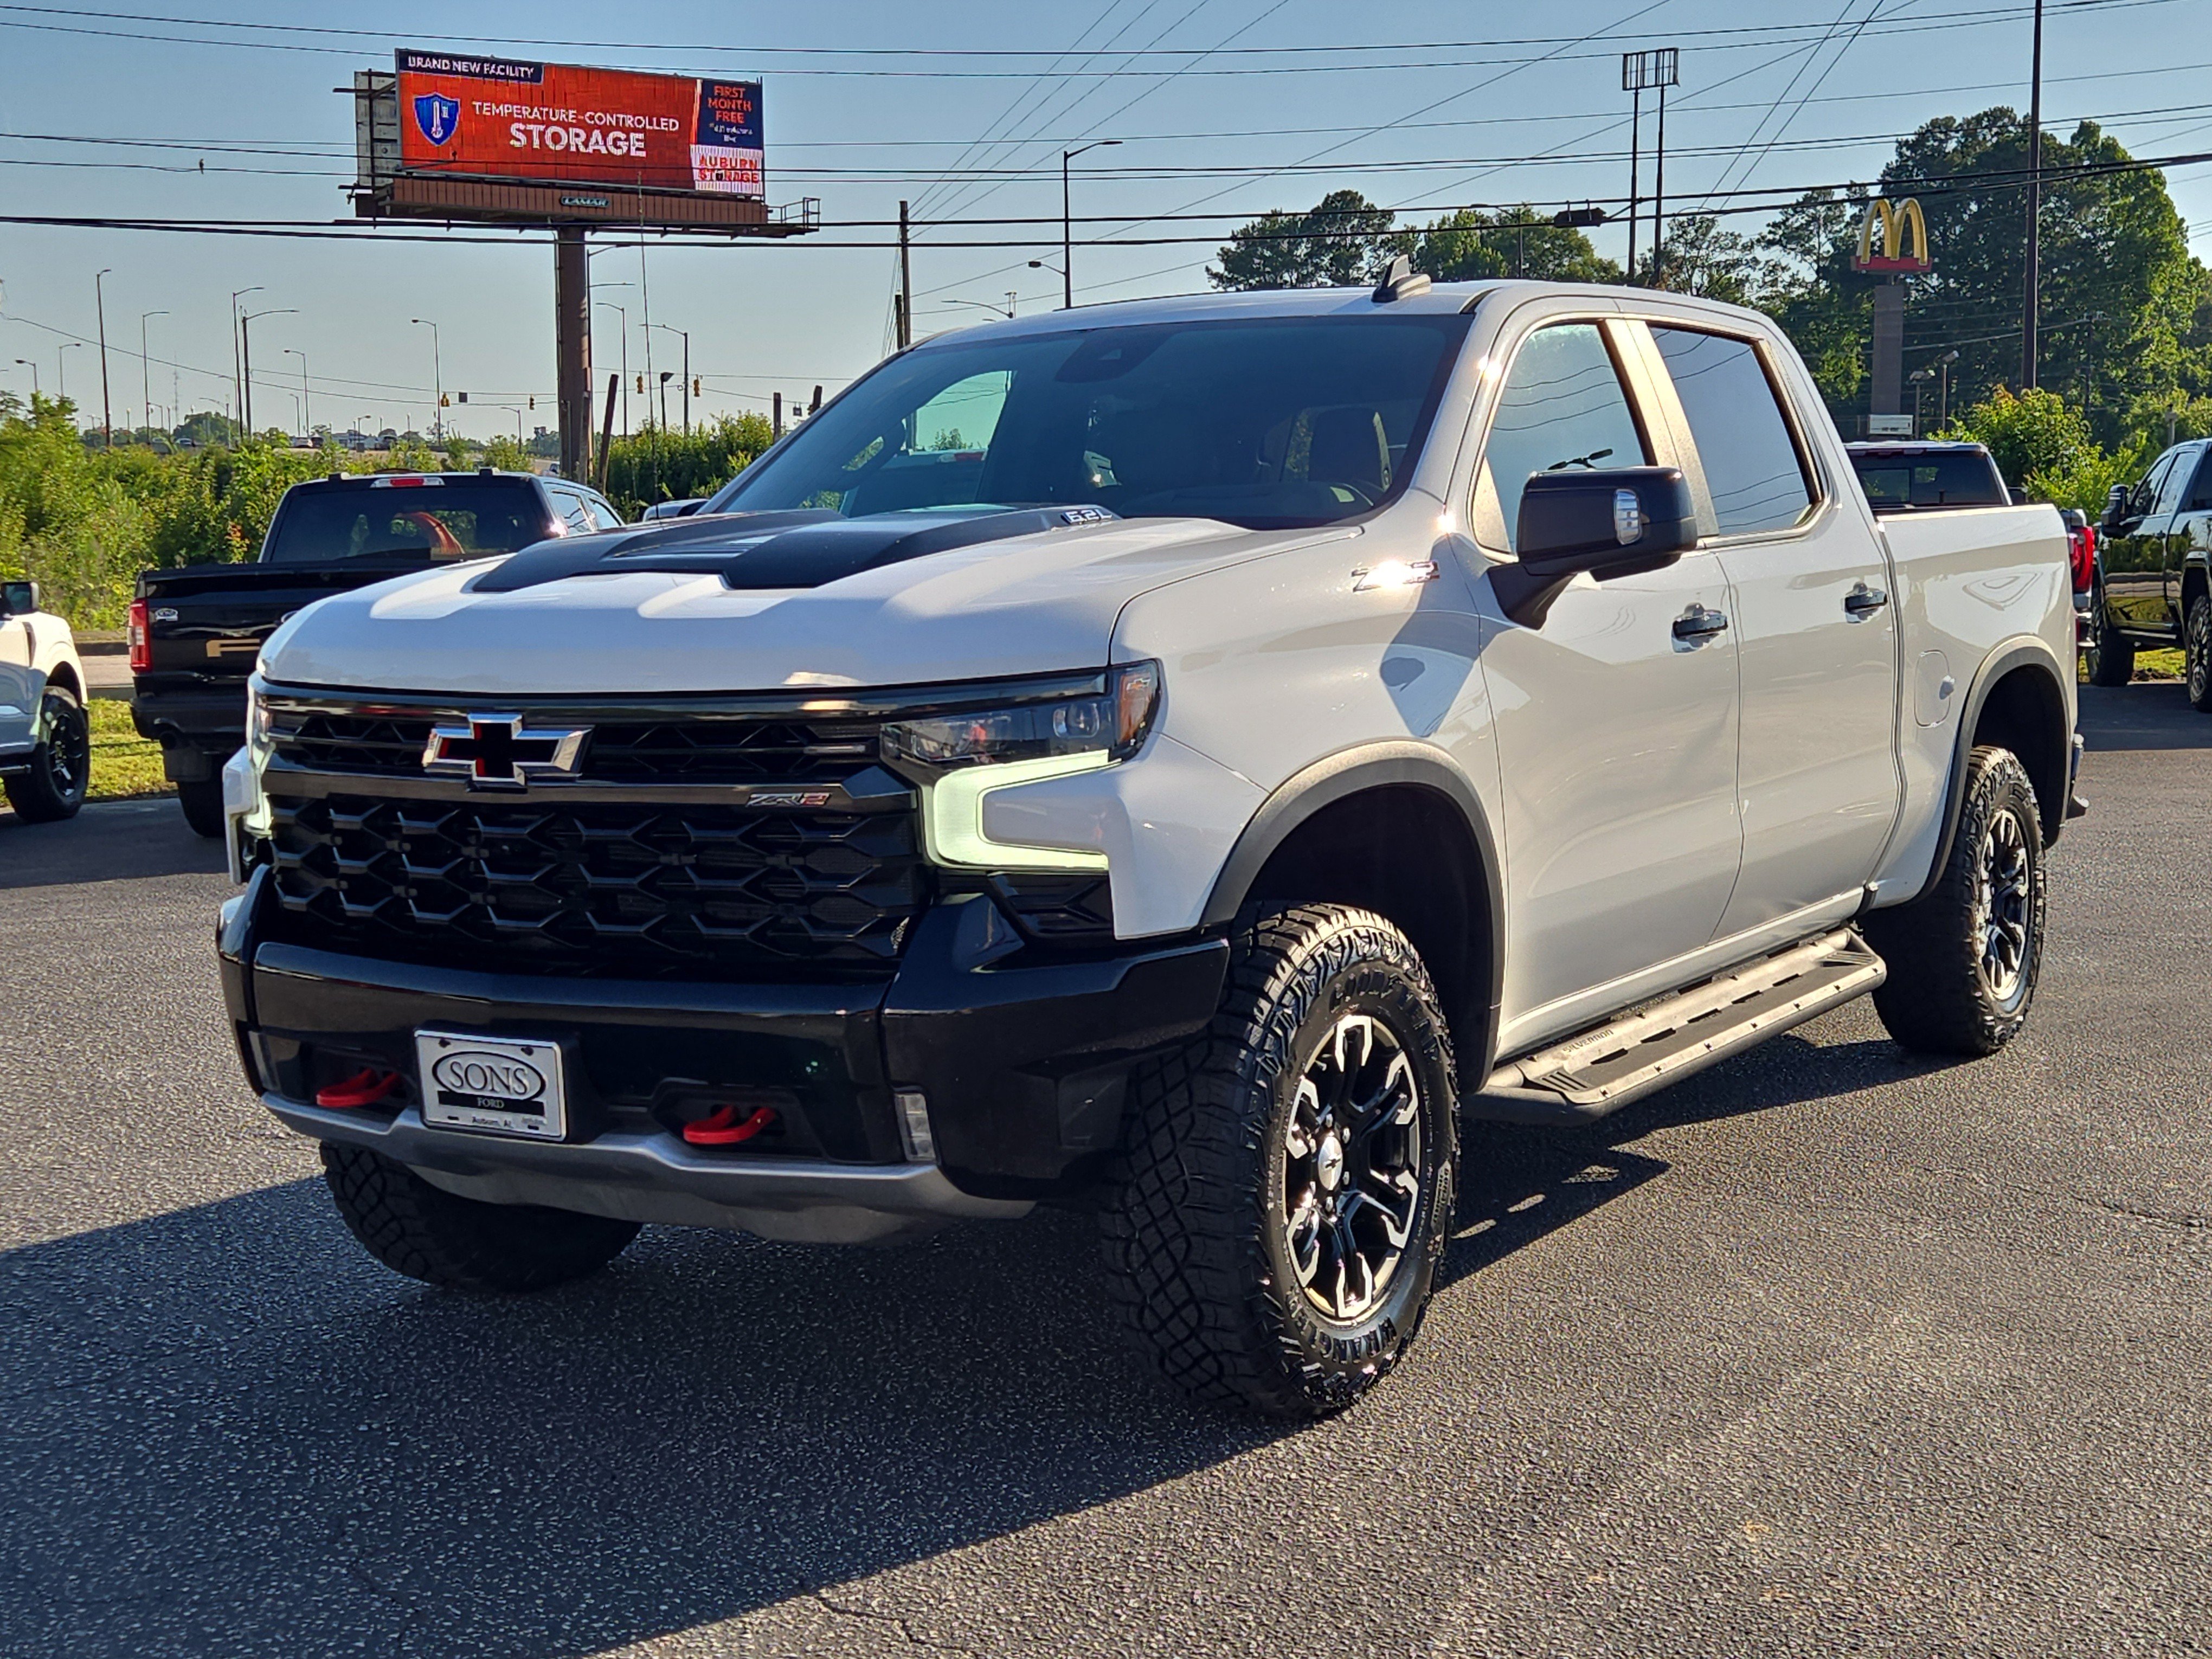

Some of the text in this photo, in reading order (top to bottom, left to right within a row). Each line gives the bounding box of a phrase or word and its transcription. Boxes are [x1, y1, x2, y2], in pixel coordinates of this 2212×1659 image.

[408, 55, 535, 79] BRAND NEW FACILITY
[713, 85, 746, 99] FIRST
[708, 98, 753, 113] MONTH
[472, 101, 679, 131] TEMPERATURE-CONTROLLED
[715, 110, 745, 124] FREE
[509, 123, 647, 158] STORAGE
[698, 155, 758, 169] AUBURN
[449, 1060, 529, 1095] SONS
[477, 1097, 505, 1109] FORD
